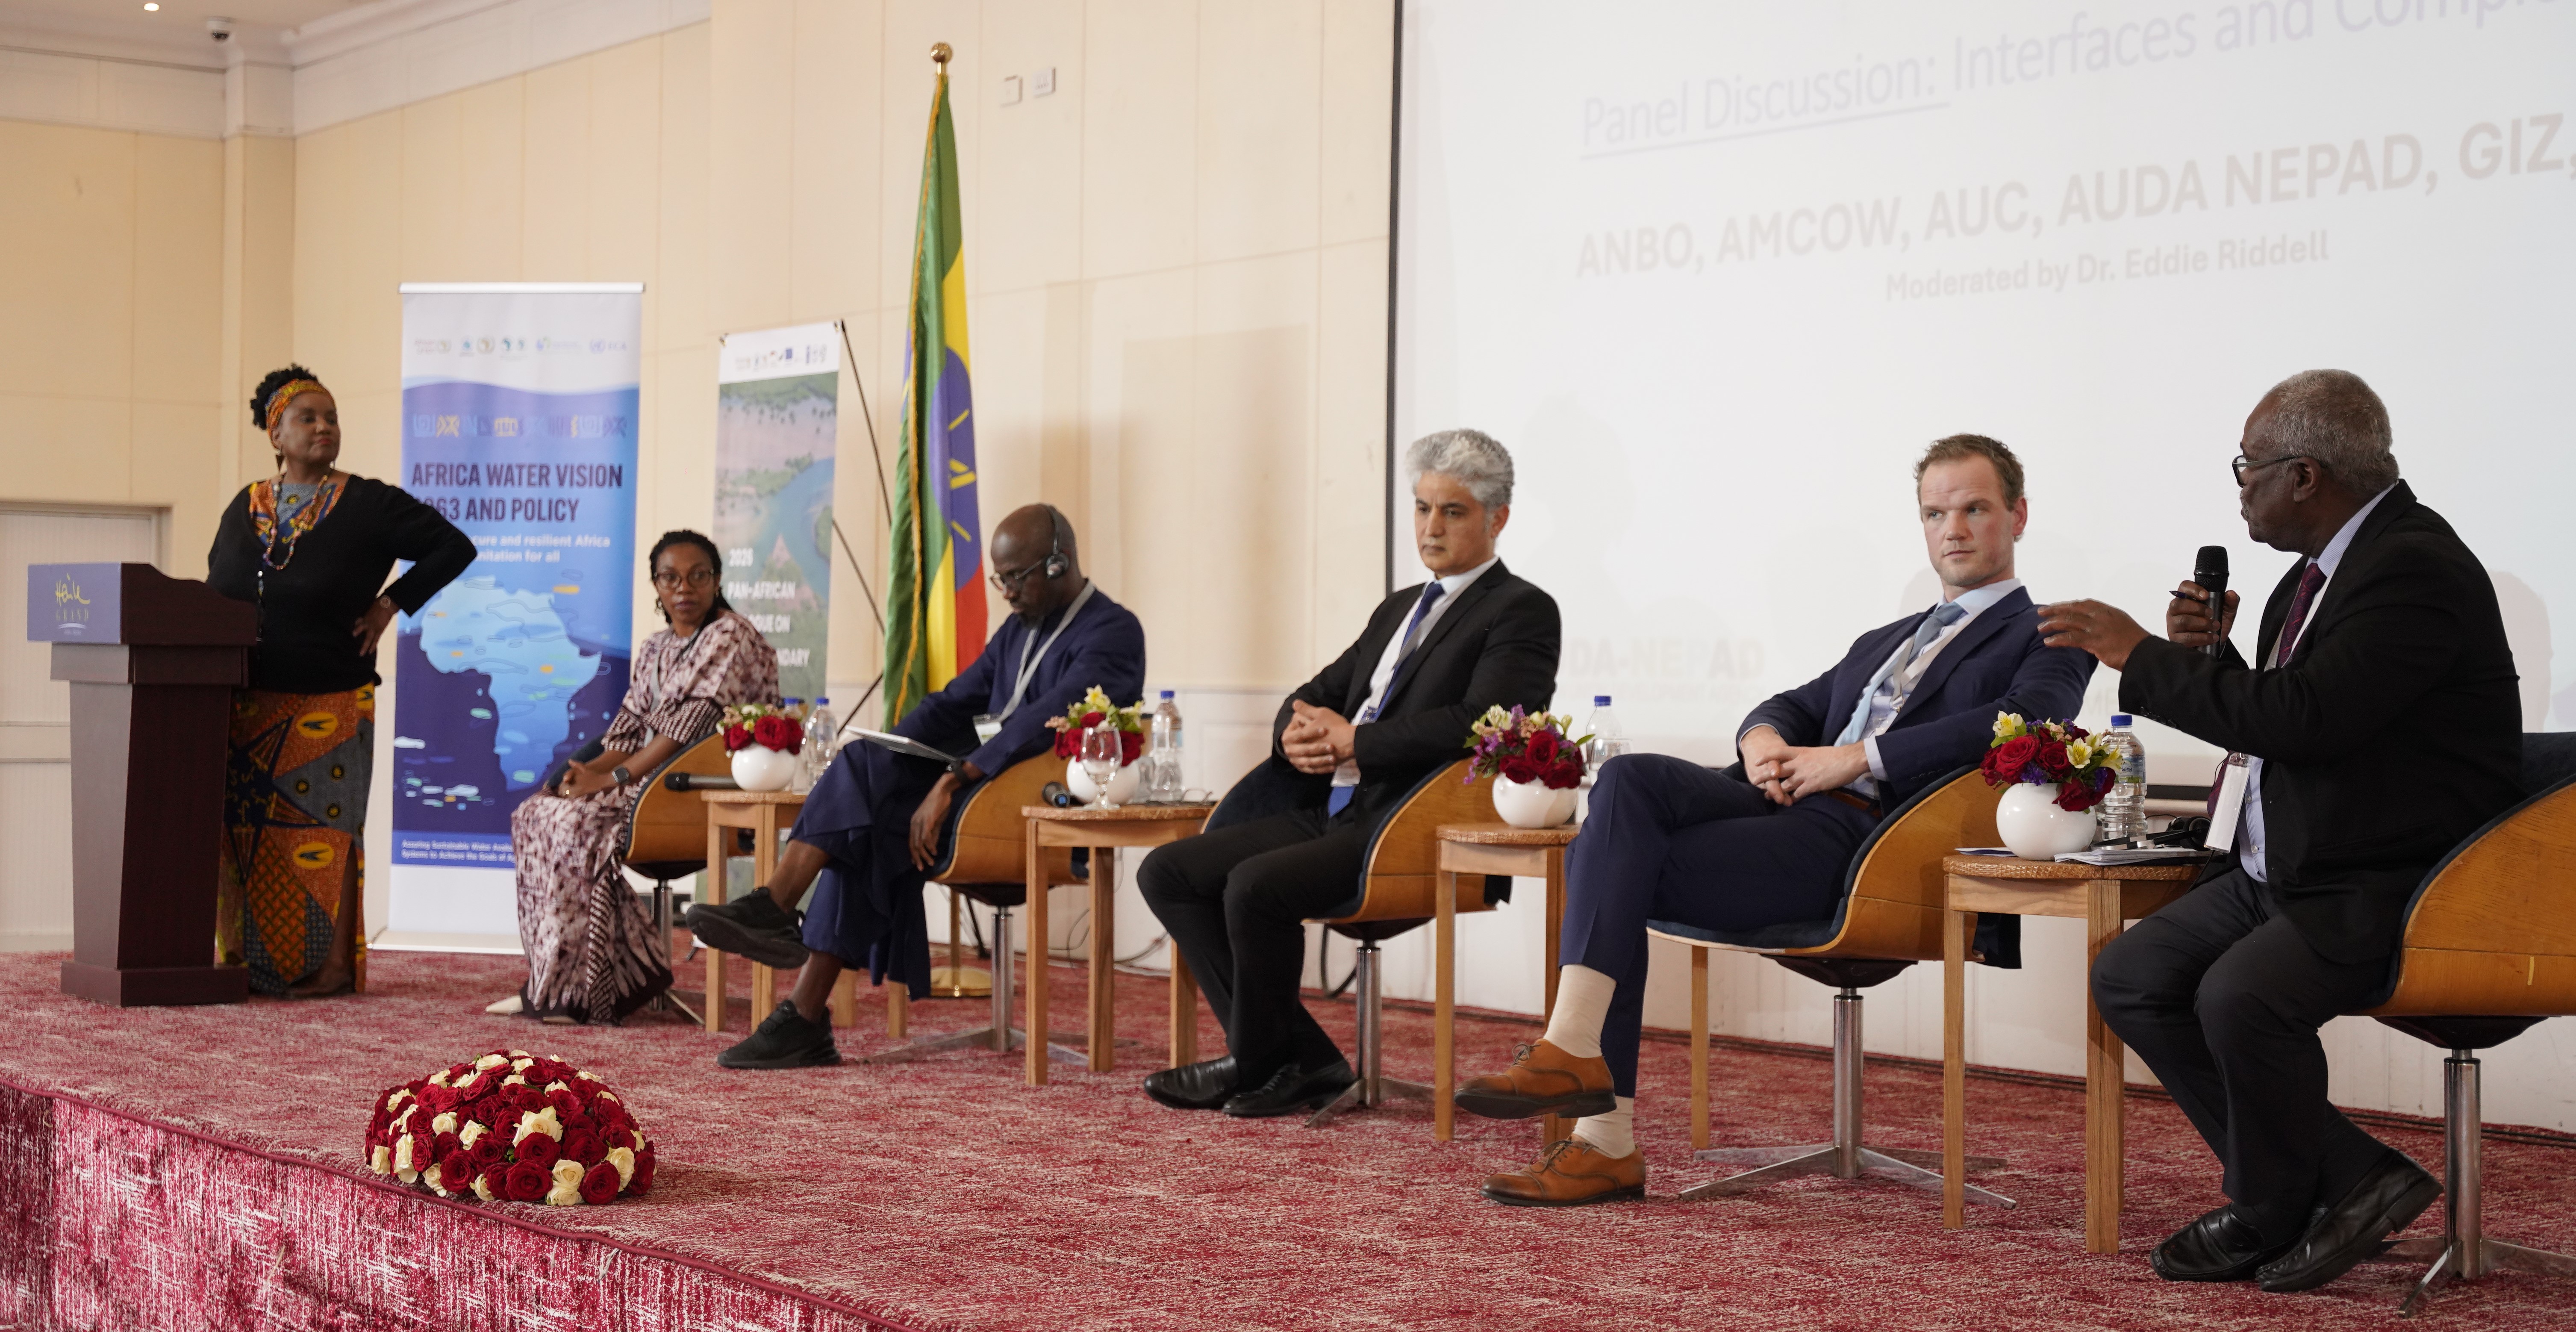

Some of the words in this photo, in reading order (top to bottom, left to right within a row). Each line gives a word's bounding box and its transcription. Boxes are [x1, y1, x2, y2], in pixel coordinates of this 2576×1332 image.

[1583, 80, 1688, 147] Panel
[1705, 53, 1936, 130] Discussion:
[1955, 10, 2196, 91] Interfaces
[2214, 0, 2314, 52] and
[1576, 222, 1705, 278] ANBO,
[1716, 196, 1911, 264] AMCOW,
[1923, 180, 2044, 242] AUC,
[2056, 159, 2209, 227] AUDA
[2224, 133, 2439, 208] NEPAD,
[1885, 260, 2029, 301] Moderated
[2036, 258, 2070, 294] by
[2076, 252, 2116, 285] Dr.
[2125, 244, 2209, 280] Eddie
[2217, 229, 2330, 270] Riddell
[412, 462, 480, 487] AFRICA
[486, 462, 550, 487] WATER
[556, 463, 623, 488] VISION
[465, 498, 506, 521] AND
[512, 498, 579, 522] POLICY
[470, 535, 498, 547] cure
[500, 534, 521, 547] and
[524, 534, 571, 547] resilient
[575, 534, 611, 548] Africa
[525, 549, 542, 563] for
[545, 549, 560, 563] all
[727, 581, 796, 599] PAN-AFRICAN
